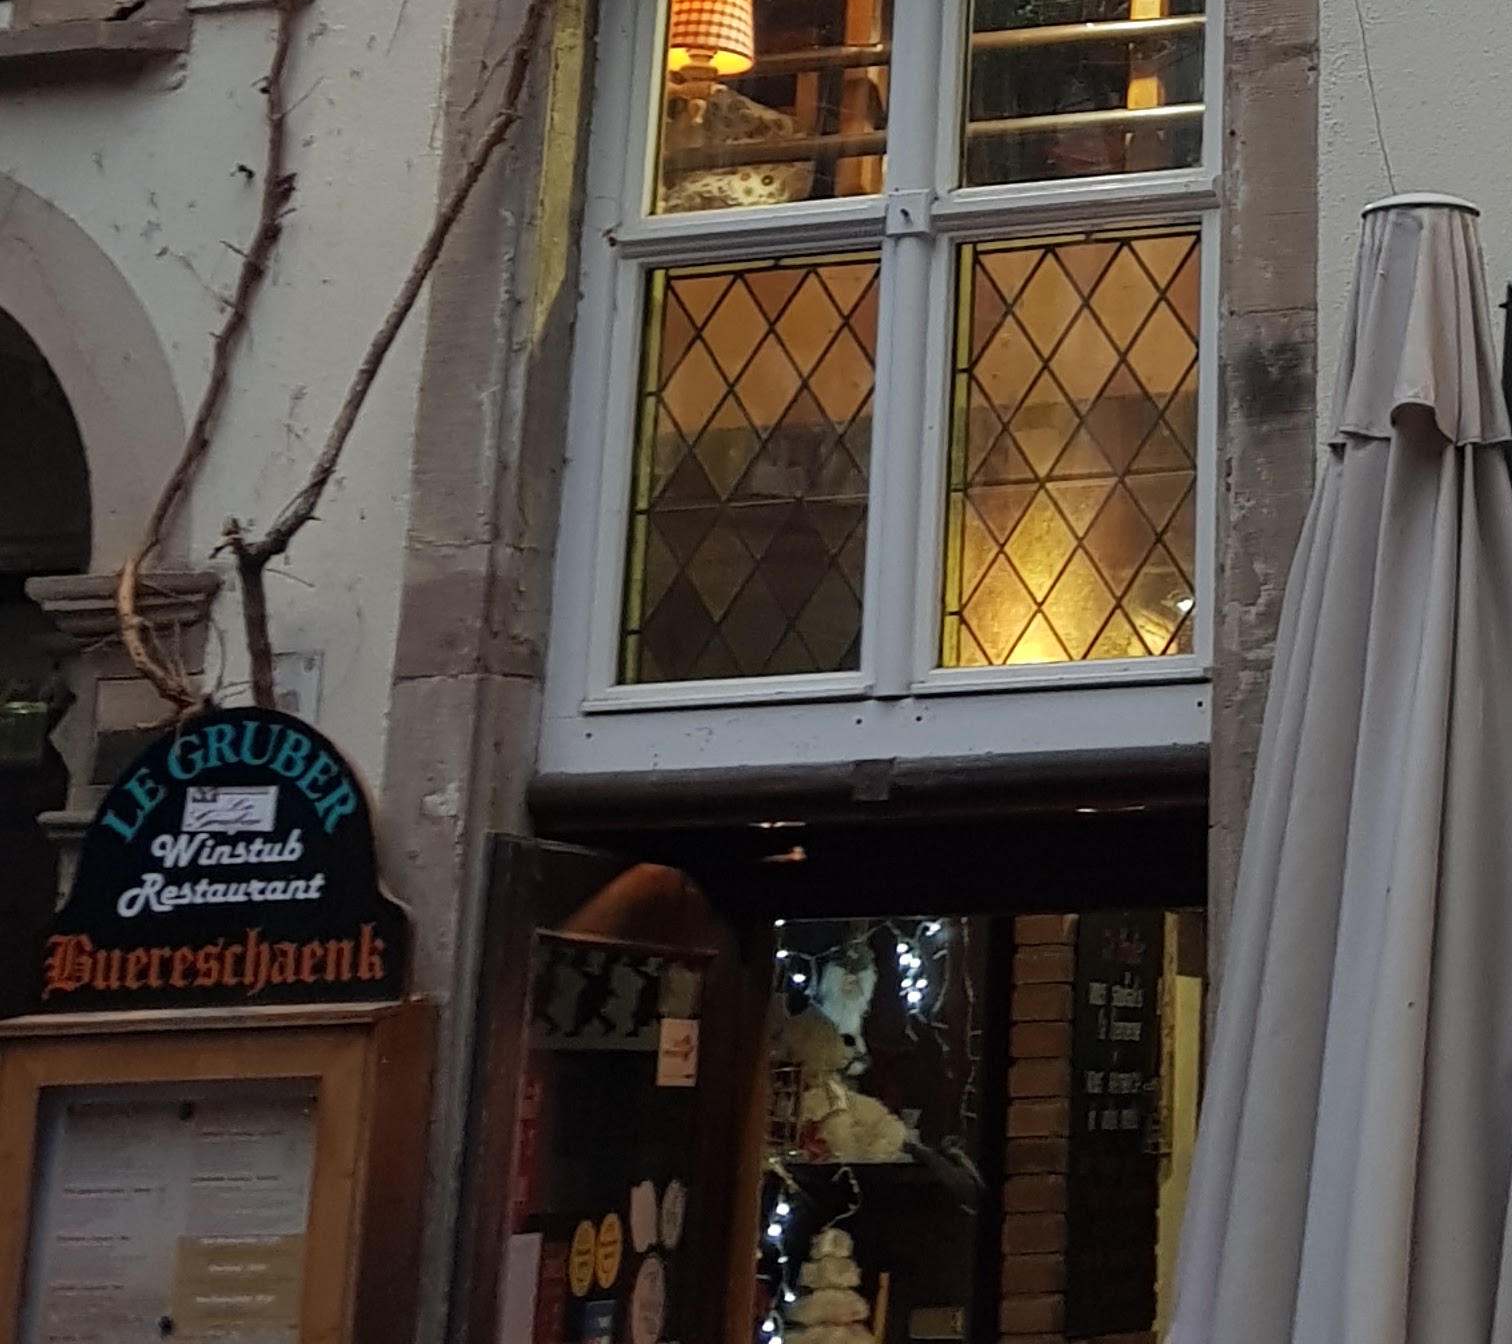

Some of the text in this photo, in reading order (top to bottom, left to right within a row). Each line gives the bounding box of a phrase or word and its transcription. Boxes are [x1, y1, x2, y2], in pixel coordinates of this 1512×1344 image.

[102, 721, 357, 841] LE GRUBER
[151, 829, 304, 869] Winstub
[117, 873, 326, 918] Restaurant
[43, 924, 384, 998] Buereschaenk
